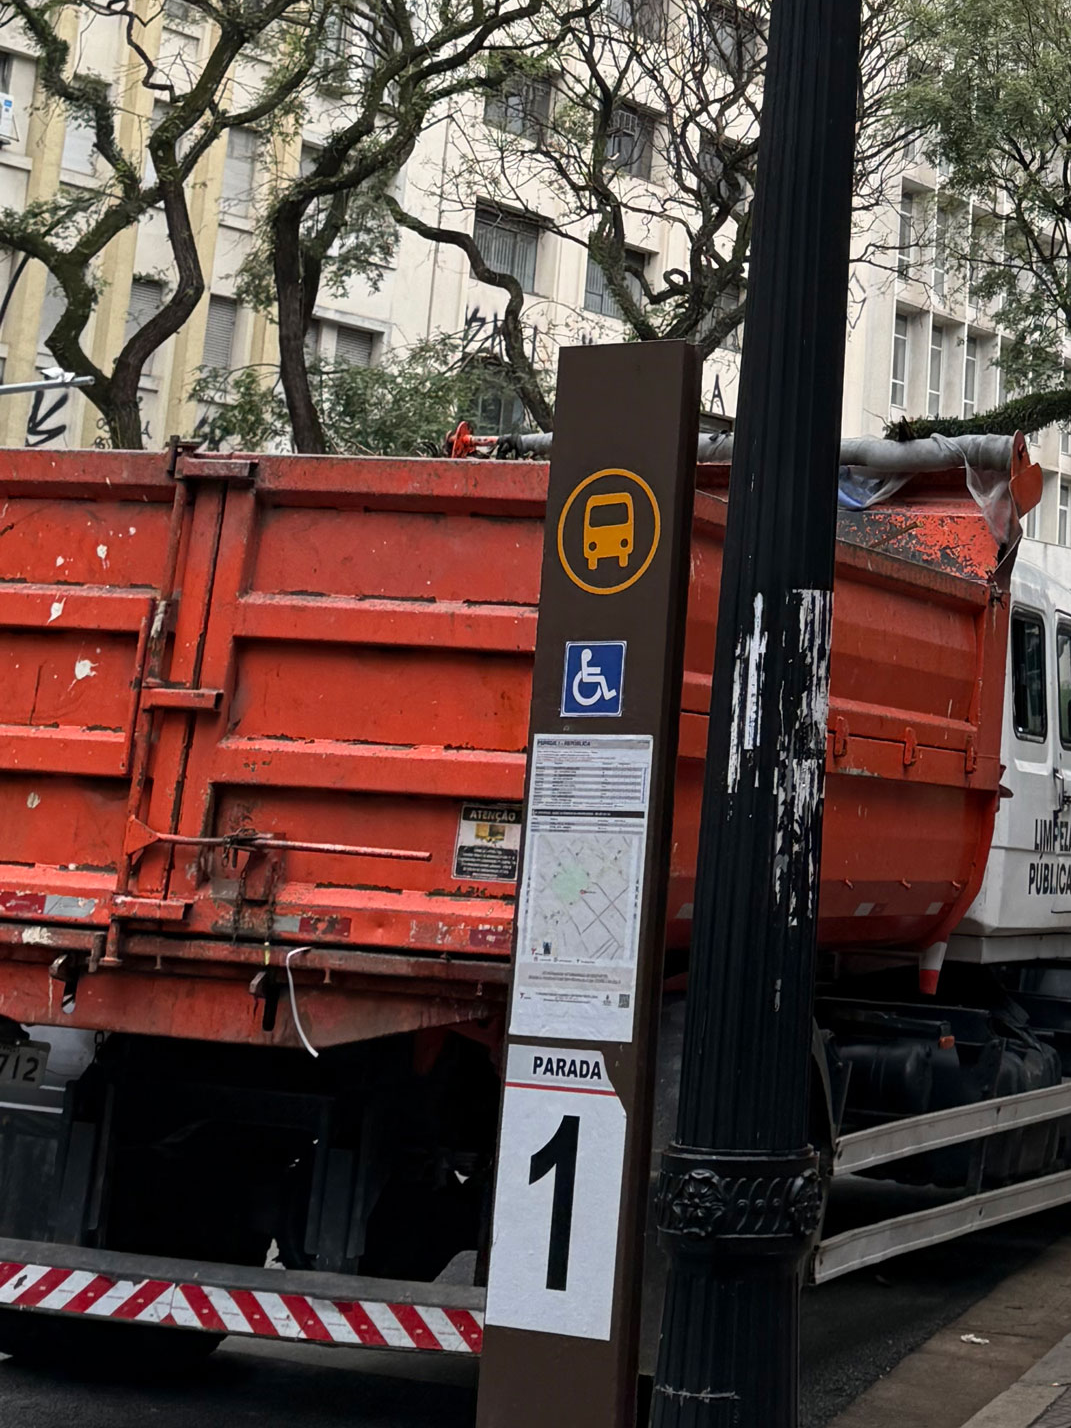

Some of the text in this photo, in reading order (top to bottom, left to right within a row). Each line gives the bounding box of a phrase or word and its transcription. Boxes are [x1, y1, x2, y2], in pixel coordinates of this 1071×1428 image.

[469, 810, 516, 823] ATENÇÃO
[532, 1056, 602, 1080] PARADA
[529, 1115, 580, 1291] 1
